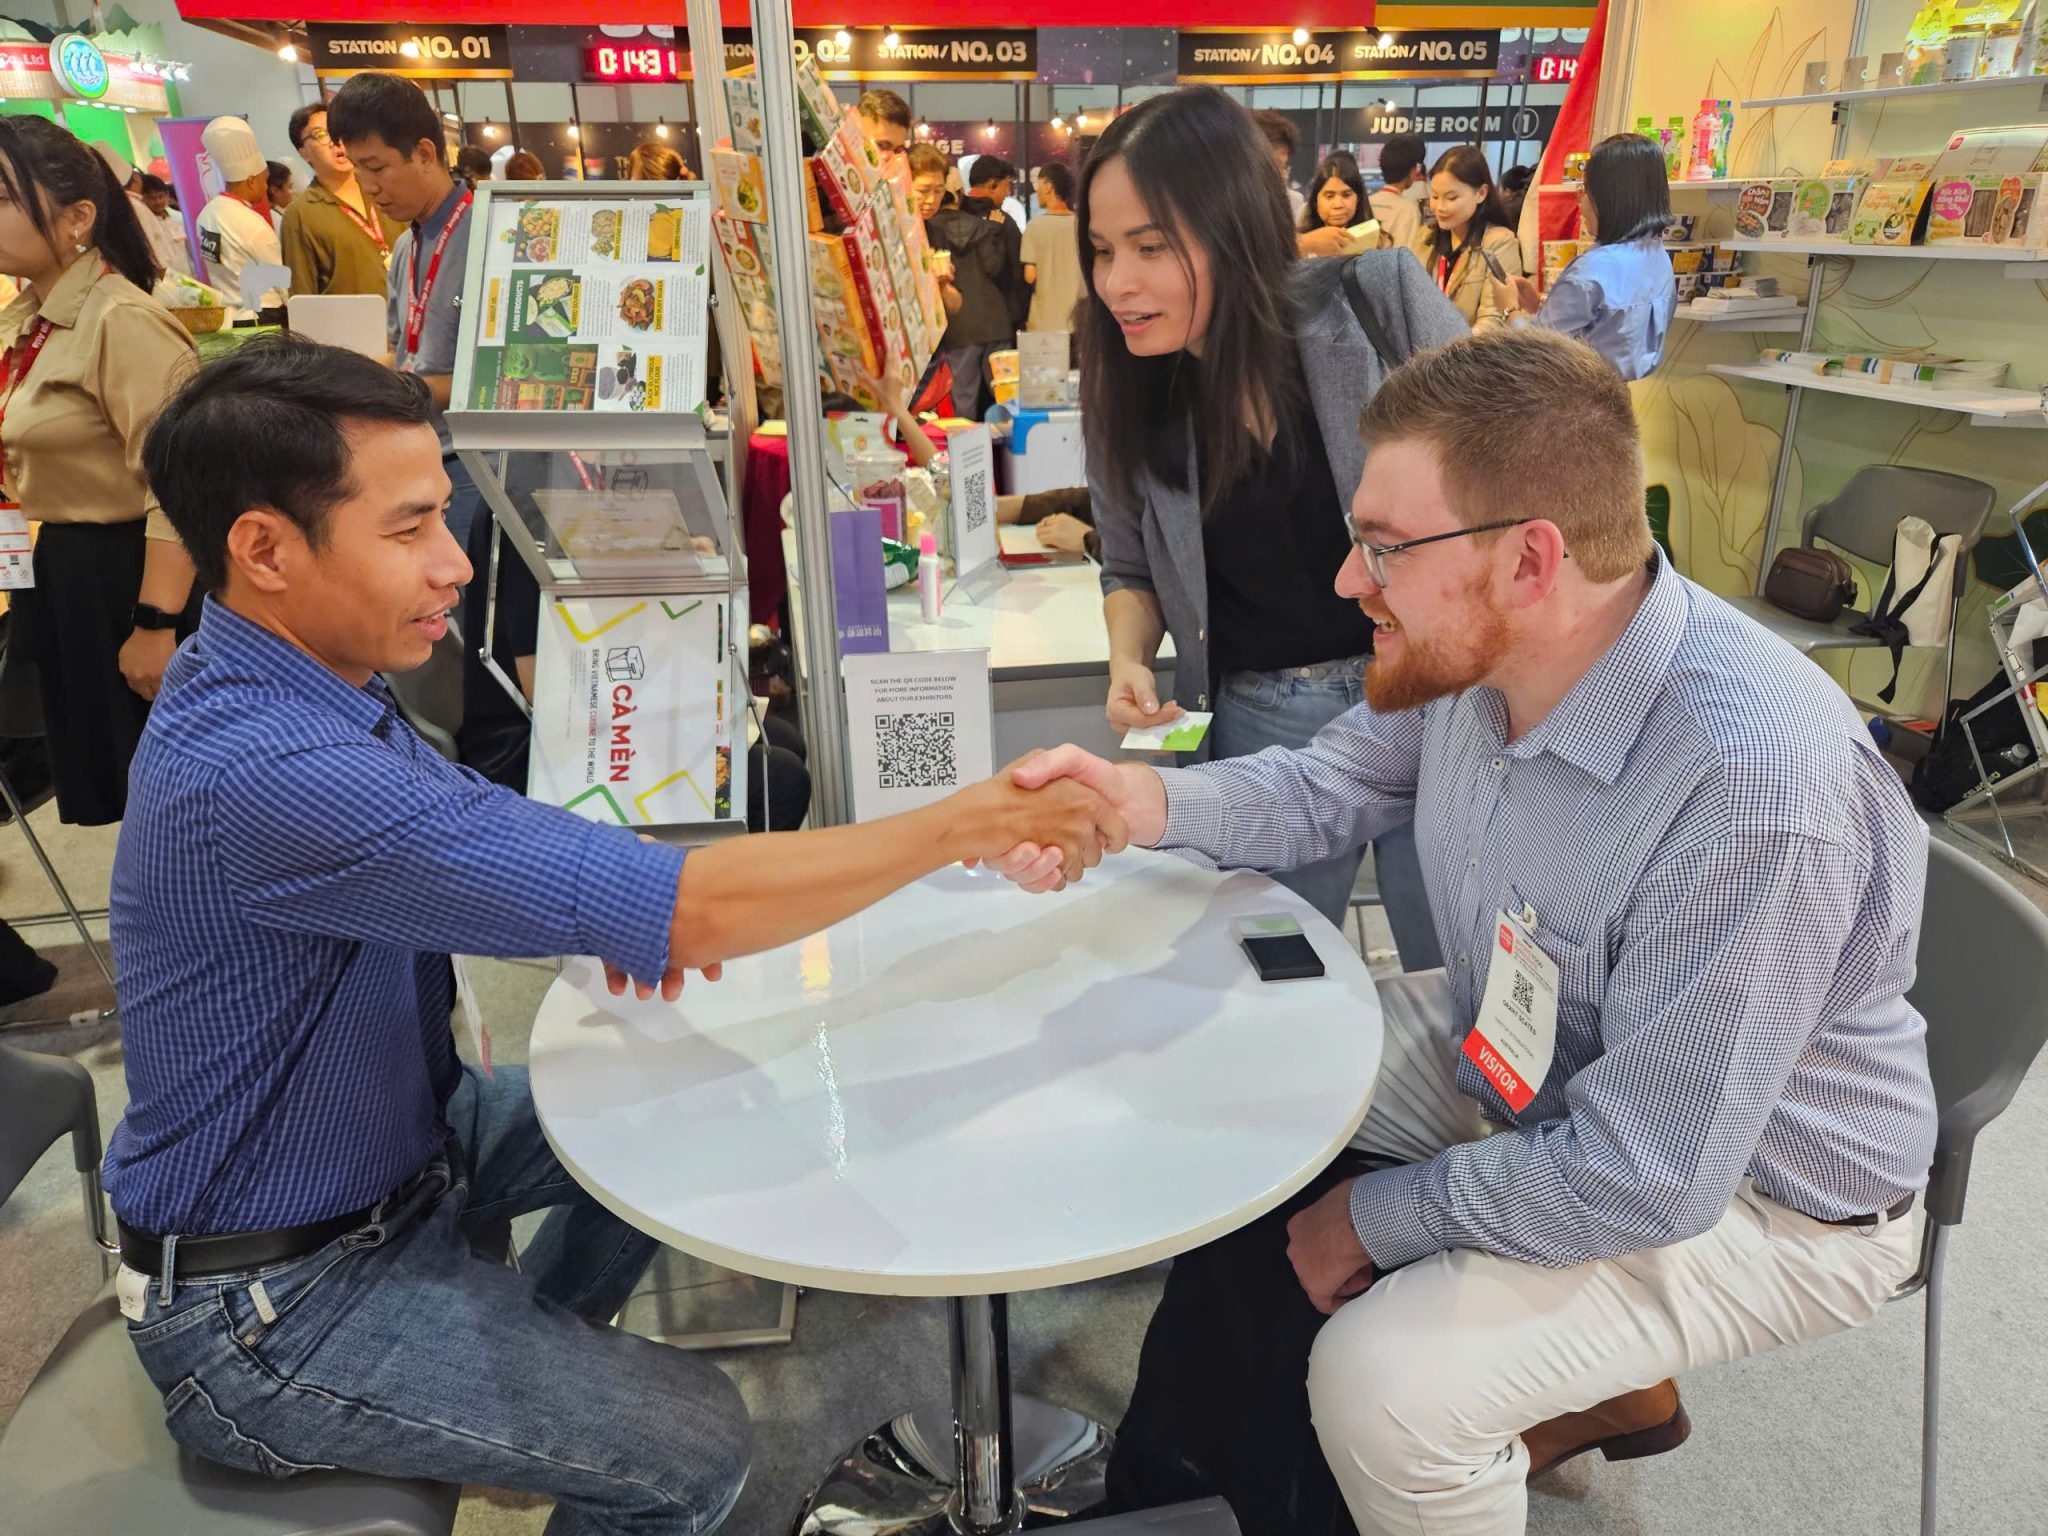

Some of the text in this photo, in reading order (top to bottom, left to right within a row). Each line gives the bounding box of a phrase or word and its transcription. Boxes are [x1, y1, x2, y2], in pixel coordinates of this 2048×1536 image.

[328, 35, 491, 59] STATION NO. 01
[723, 44, 754, 57] TION
[816, 39, 851, 63] 02
[951, 41, 993, 62] NO.
[996, 41, 1027, 62] 03
[1261, 44, 1302, 65] NO.
[1304, 44, 1335, 65] 04
[1419, 41, 1456, 61] NO.
[1459, 41, 1487, 61] 05
[1370, 116, 1436, 135] JUDGE
[1440, 115, 1501, 133] ROOM
[512, 280, 524, 332] MAIN PRODUCTS
[586, 649, 600, 783] BRING VIETNAMESE CUISINE TO THE WORLD
[609, 684, 638, 782] CÀ MÈN
[1478, 1045, 1518, 1095] VISITOR
